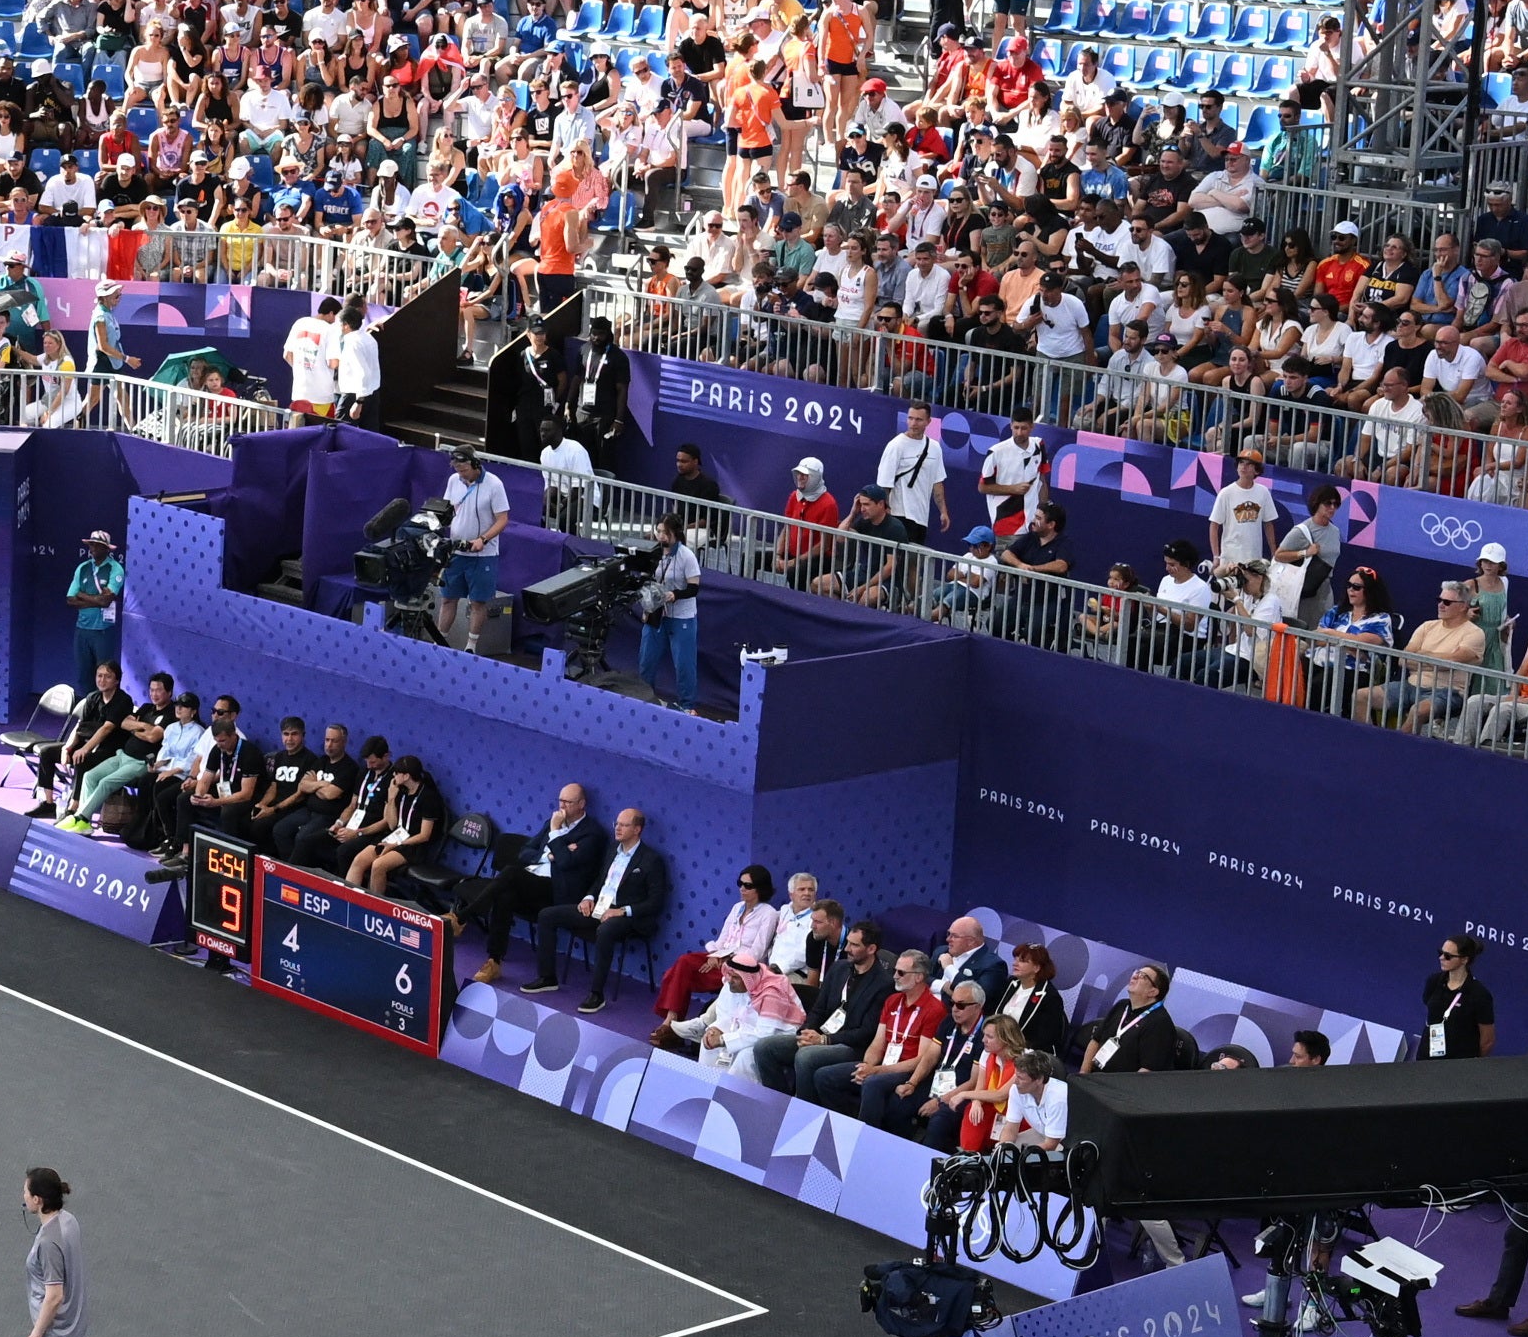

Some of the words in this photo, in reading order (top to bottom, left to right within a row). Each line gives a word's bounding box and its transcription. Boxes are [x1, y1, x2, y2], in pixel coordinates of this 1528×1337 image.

[3, 226, 15, 242] P
[691, 380, 773, 417] PARIS
[784, 397, 863, 435] 2024
[980, 787, 1022, 810] PARIS
[1027, 800, 1064, 823] 2024
[1090, 819, 1135, 843] PARIS
[1140, 833, 1181, 856] 2024
[208, 847, 246, 882] 6:54
[1208, 851, 1255, 876] PARIS
[1261, 866, 1303, 890] 2024
[27, 848, 90, 889] PARIS
[93, 873, 151, 913] 2024
[221, 884, 243, 933] 9
[303, 892, 331, 916] ESP
[1333, 885, 1382, 910] PARIS
[1387, 900, 1434, 925] 2024
[364, 913, 396, 942] USA
[402, 910, 434, 930] OMEGA
[1465, 921, 1516, 948] PARIS
[207, 938, 235, 956] OMEGA
[282, 922, 300, 954] 4
[279, 957, 301, 972] FOULS
[395, 963, 413, 995] 6
[286, 974, 294, 988] 2
[391, 1000, 414, 1015] FOULS
[399, 1017, 406, 1031] 3
